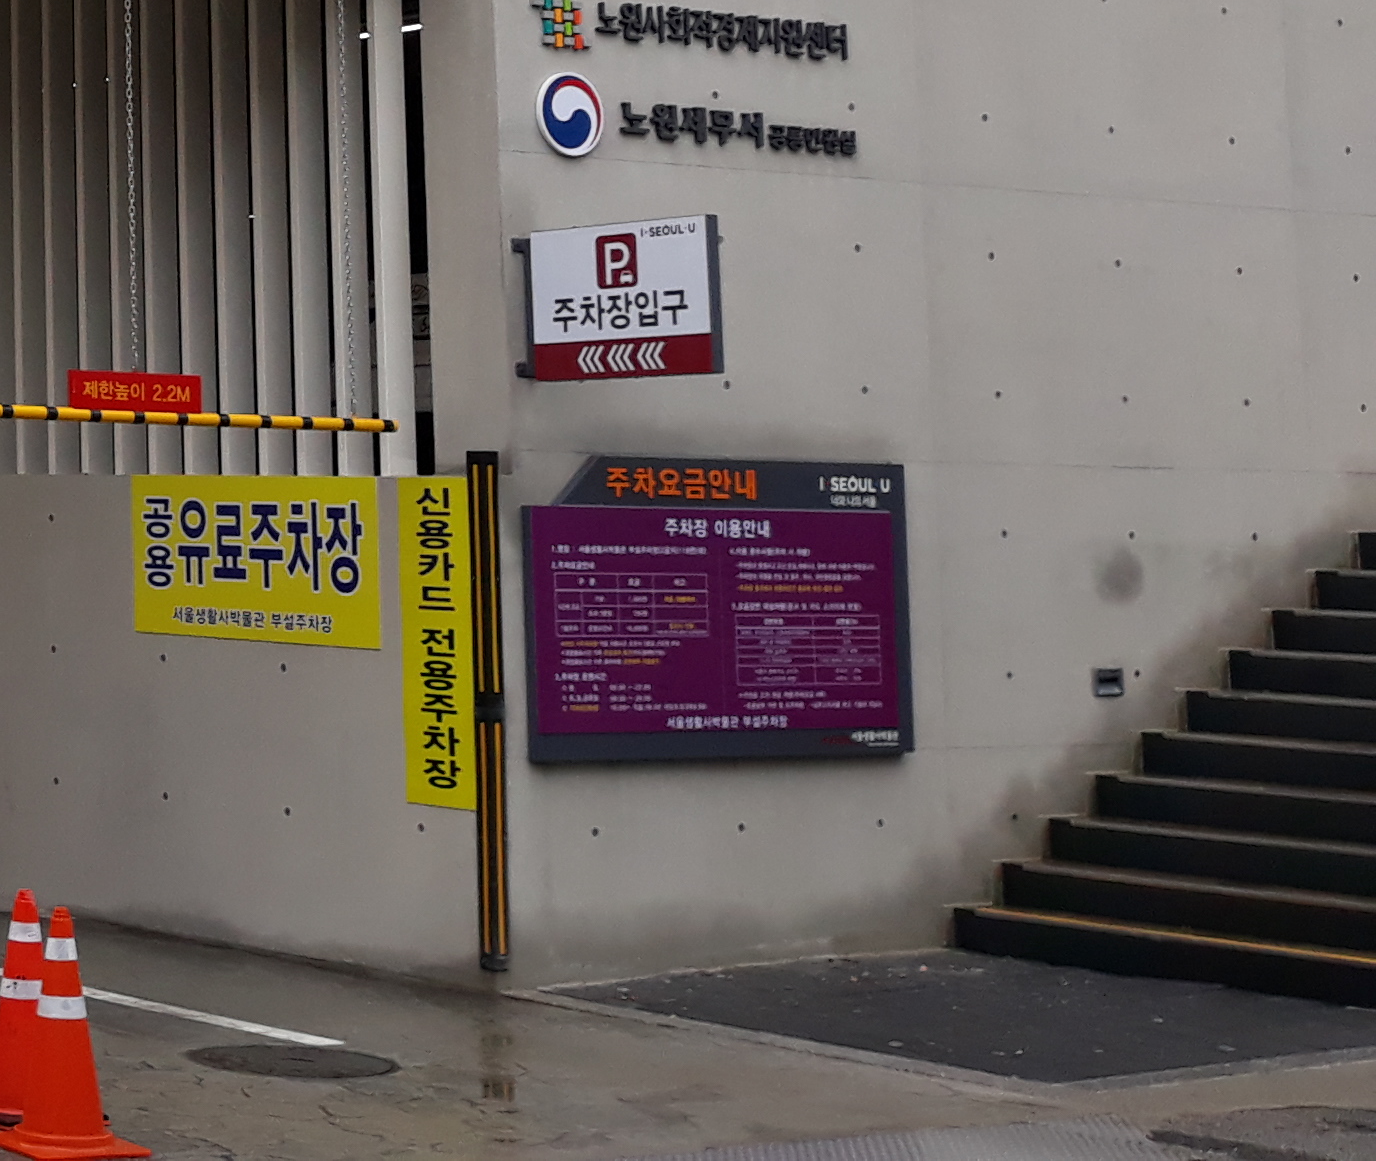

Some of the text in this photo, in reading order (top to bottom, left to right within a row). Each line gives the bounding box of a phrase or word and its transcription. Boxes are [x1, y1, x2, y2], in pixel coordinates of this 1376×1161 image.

[595, 1, 848, 61] 노원사회적경제지원센터
[619, 101, 764, 149] 노원세무서
[552, 289, 689, 333] 주차장입구
[82, 379, 191, 402] 제한높이 2.2M
[605, 467, 759, 501] 주차요금안내
[177, 499, 363, 594] 유료주차장
[664, 518, 772, 538] 주차장 이용안내
[172, 606, 334, 634] 서울생활사박물관 부설주차장
[415, 487, 462, 790] 신용카드 전용주차장
